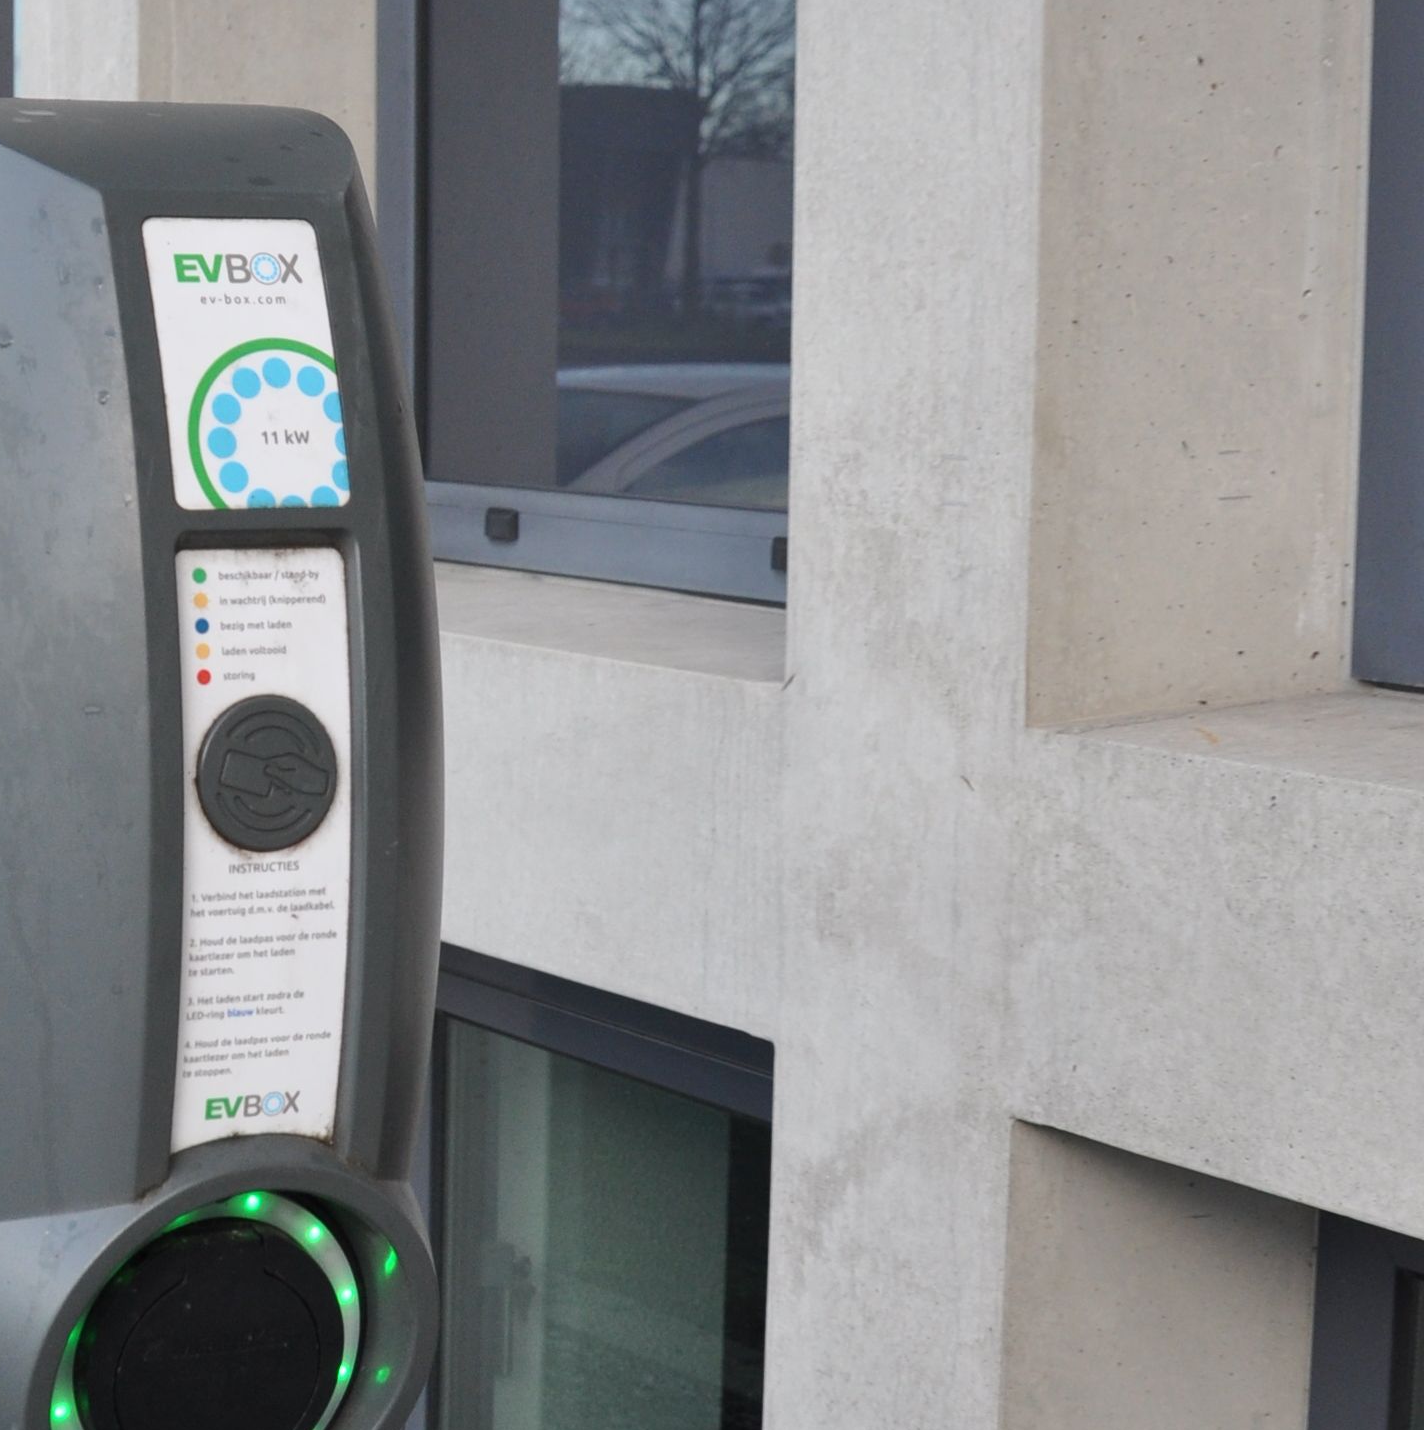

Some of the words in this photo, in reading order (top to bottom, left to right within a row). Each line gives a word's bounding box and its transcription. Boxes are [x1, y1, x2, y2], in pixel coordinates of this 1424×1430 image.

[174, 252, 303, 285] EVBOX
[200, 294, 286, 305] ev-box.com
[261, 431, 278, 445] 11
[285, 430, 309, 444] kW
[218, 571, 272, 581] beschikbaar
[219, 597, 228, 605] in
[230, 596, 266, 606] wachtrij
[269, 594, 326, 606] (knipperend)
[220, 621, 244, 632] bezig
[247, 621, 264, 630] met
[267, 620, 292, 629] laden
[222, 647, 247, 656] laden
[249, 646, 287, 655] voltooid
[224, 672, 255, 681] storing
[229, 861, 299, 874] INSTRUCTIES
[201, 892, 236, 902] Verbind
[239, 891, 253, 899] het
[256, 888, 306, 898] laadstation
[309, 887, 326, 896] met
[191, 908, 205, 917] het
[208, 906, 246, 916] voertuig
[277, 904, 288, 912] de
[200, 937, 224, 947] Houd
[226, 936, 237, 945] de
[240, 934, 273, 946] laadpas
[276, 933, 295, 942] voor
[298, 931, 309, 940] de
[311, 930, 337, 940] ronde
[189, 951, 235, 962] kaartlezer
[237, 951, 251, 959] om
[253, 949, 268, 958] het
[271, 947, 295, 957] laden
[188, 968, 197, 977] te
[198, 996, 213, 1005] Het
[216, 994, 240, 1004] laden
[243, 993, 264, 1002] start
[266, 991, 291, 1001] zodra
[293, 990, 304, 999] de
[227, 1008, 253, 1018] blauw
[195, 1039, 218, 1048] Houd
[221, 1038, 232, 1047] de
[234, 1036, 268, 1046] laadpas
[270, 1034, 290, 1043] voor
[292, 1032, 303, 1041] de
[306, 1030, 331, 1040] ronde
[183, 1052, 229, 1063] kaartlezer
[231, 1052, 245, 1060] om
[248, 1049, 262, 1059] het
[265, 1048, 289, 1058] laden
[182, 1069, 191, 1079] te
[204, 1090, 301, 1121] EVBOX
